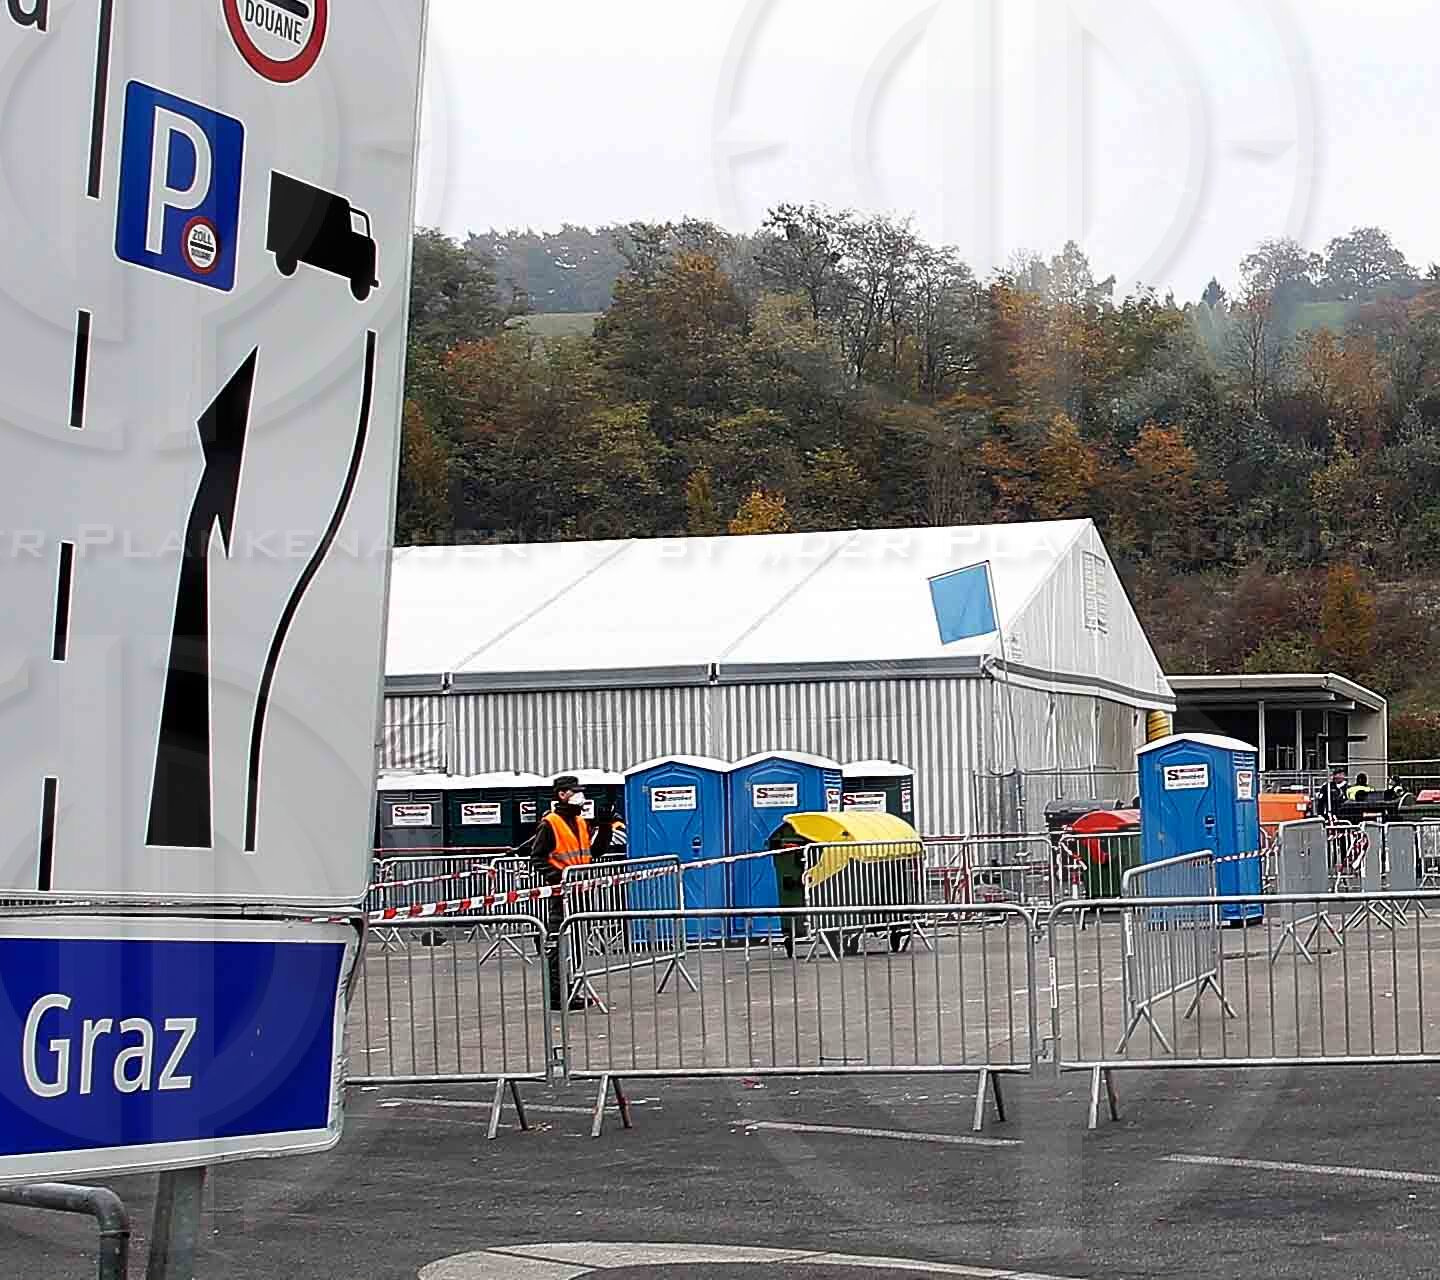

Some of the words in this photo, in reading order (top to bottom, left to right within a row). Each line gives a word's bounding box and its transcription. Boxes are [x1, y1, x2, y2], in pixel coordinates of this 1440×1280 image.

[244, 0, 303, 46] DOUANE
[145, 105, 213, 255] P
[22, 994, 197, 1098] Graz
